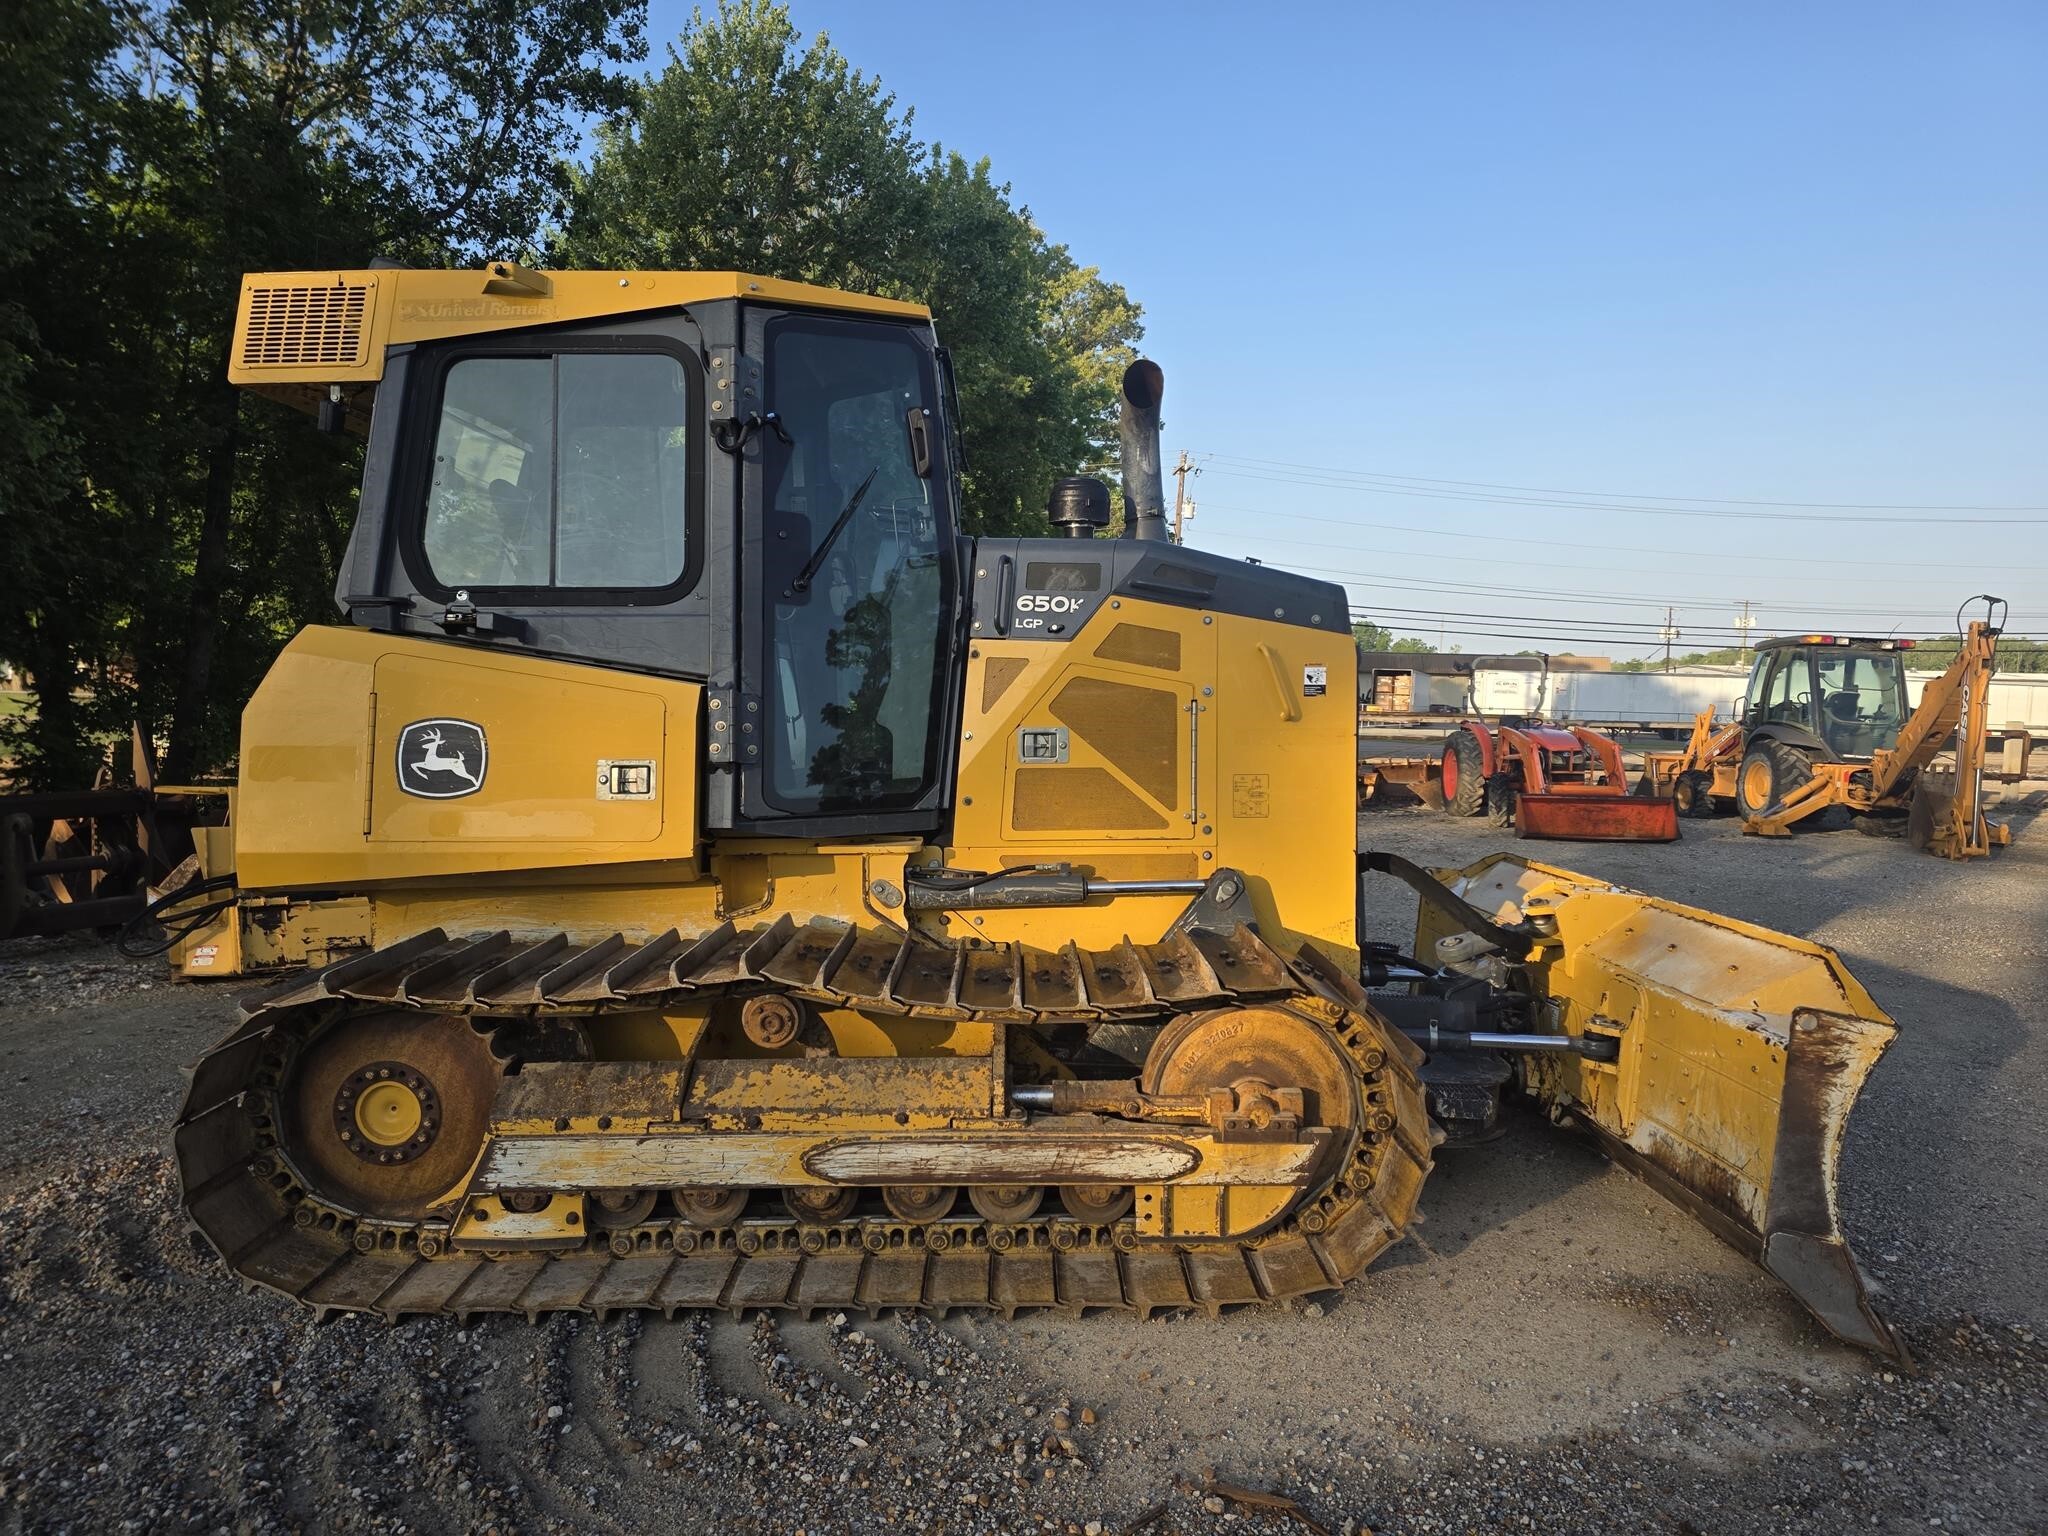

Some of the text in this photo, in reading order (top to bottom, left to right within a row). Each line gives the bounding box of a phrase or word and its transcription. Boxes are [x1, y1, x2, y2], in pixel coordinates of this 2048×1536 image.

[428, 301, 550, 318] United Rentals
[1016, 594, 1084, 613] 650K
[1015, 618, 1043, 628] LGP
[1960, 685, 1970, 742] CASE
